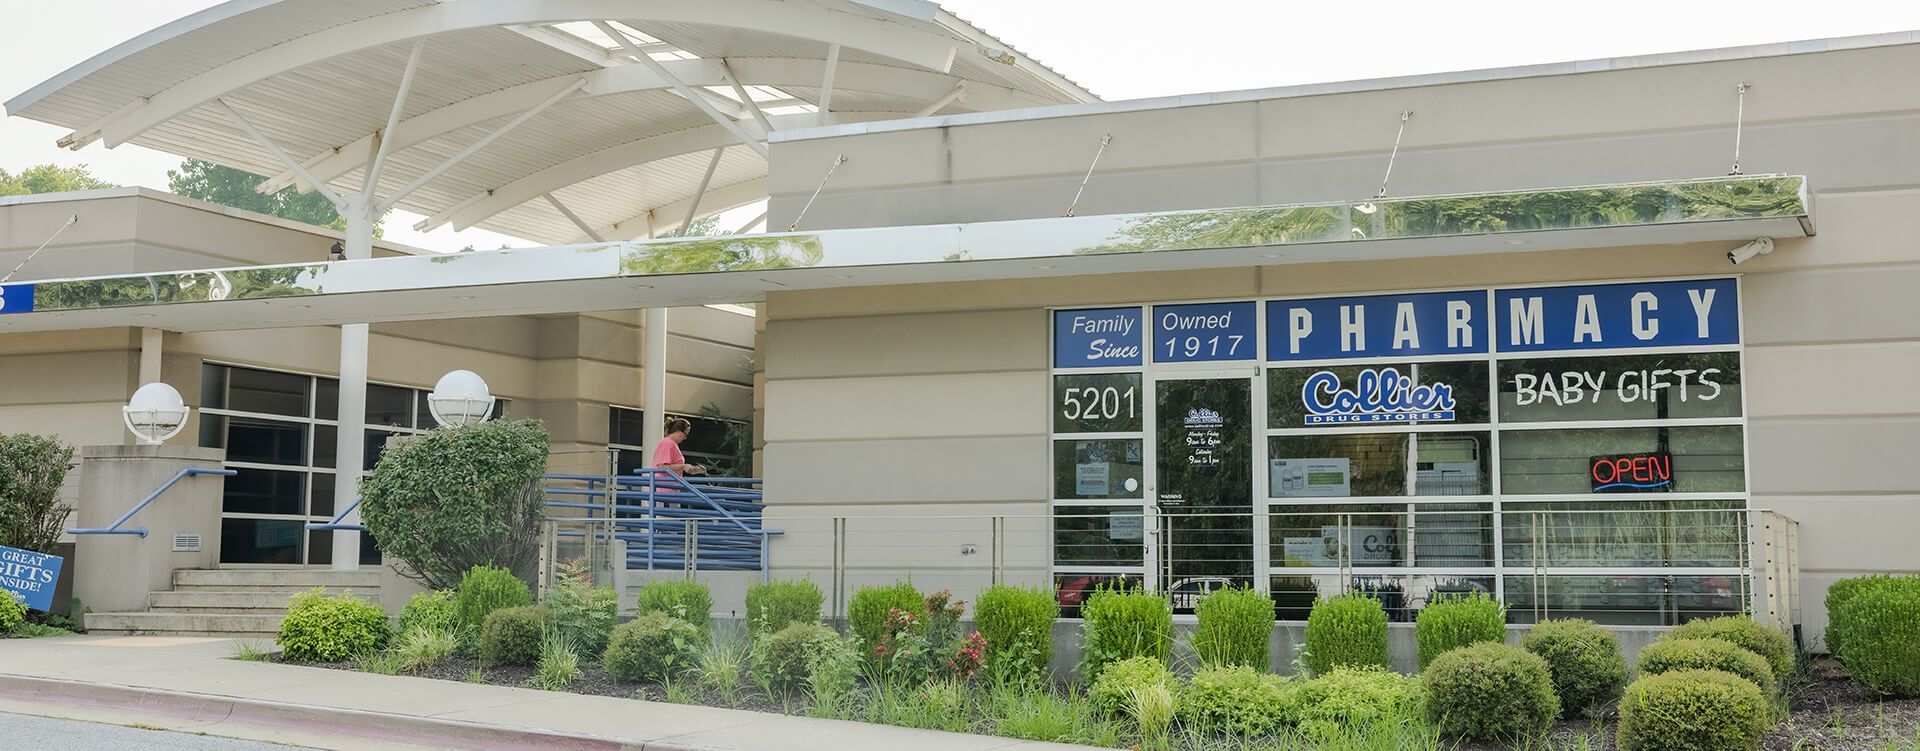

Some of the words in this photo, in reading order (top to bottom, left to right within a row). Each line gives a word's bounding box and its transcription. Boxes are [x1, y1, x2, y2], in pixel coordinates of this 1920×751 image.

[1072, 315, 1135, 336] Family
[1162, 311, 1232, 331] Owned
[1289, 288, 1717, 354] PHARMACY
[1087, 338, 1140, 360] Since
[1165, 335, 1244, 358] 1917
[1302, 367, 1456, 415] Collier
[1515, 371, 1606, 406] BABY
[1617, 368, 1721, 403] GIFTS
[1063, 386, 1135, 420] 5201
[1313, 414, 1361, 423] DRUG
[1371, 412, 1443, 421] STORES
[1592, 455, 1670, 483] OPEN
[2, 551, 46, 567] GREAT
